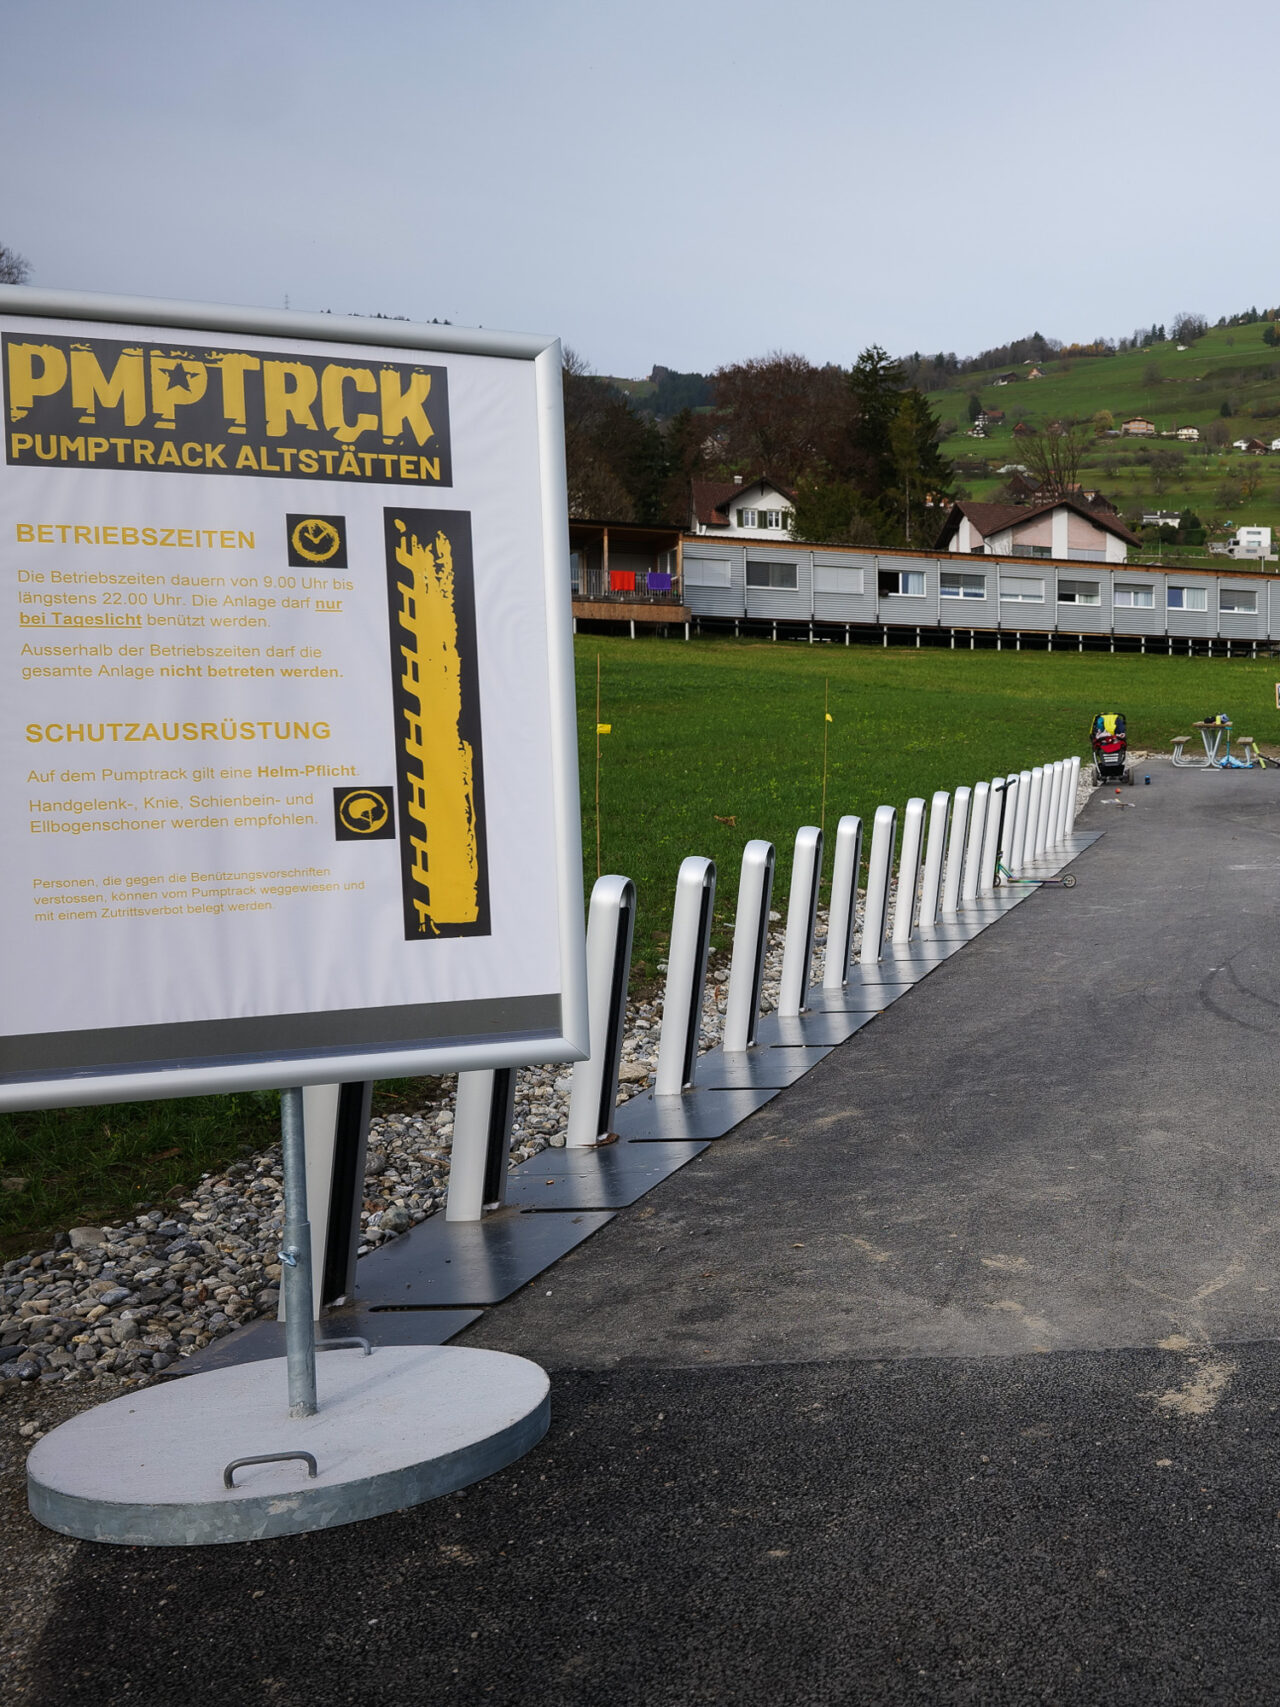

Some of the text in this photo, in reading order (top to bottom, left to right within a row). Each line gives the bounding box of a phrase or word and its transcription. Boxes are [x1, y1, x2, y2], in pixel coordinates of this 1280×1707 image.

[7, 342, 436, 446] PMPTRCK
[11, 433, 441, 481] PUMPTRACK ALTSTÄTTEN
[16, 524, 255, 548] BETRIEBSZEITEN
[17, 570, 353, 590] Die Betriebszeiten dauern von 9.00 Uhr bis
[19, 592, 343, 612] längstens 22.00 Uhr. Die Anlage darf nur
[20, 613, 271, 628] bei Tageslicht benützt werden.
[21, 643, 322, 658] Ausserhalb der Betriebszeiten darf die
[22, 665, 344, 679] gesamte Anlage nicht betreten werden.
[26, 718, 331, 743] SCHUTZAUSRÜSTUNG
[27, 764, 360, 783] Auf dem Pumptrack gilt eine Helm-Pflicht.
[29, 794, 314, 815] Handgelenk-, Knie, Schienbein- und
[30, 813, 319, 835] Ellbogenschoner werden empfohlen.
[33, 867, 331, 890] Personen, die gegen die Benützungsvorschriften
[33, 881, 365, 906] verstossen, können vom Pumptrack weggewiesen und
[33, 901, 276, 922] mit einem Zutrittsverbot belegt werden.
